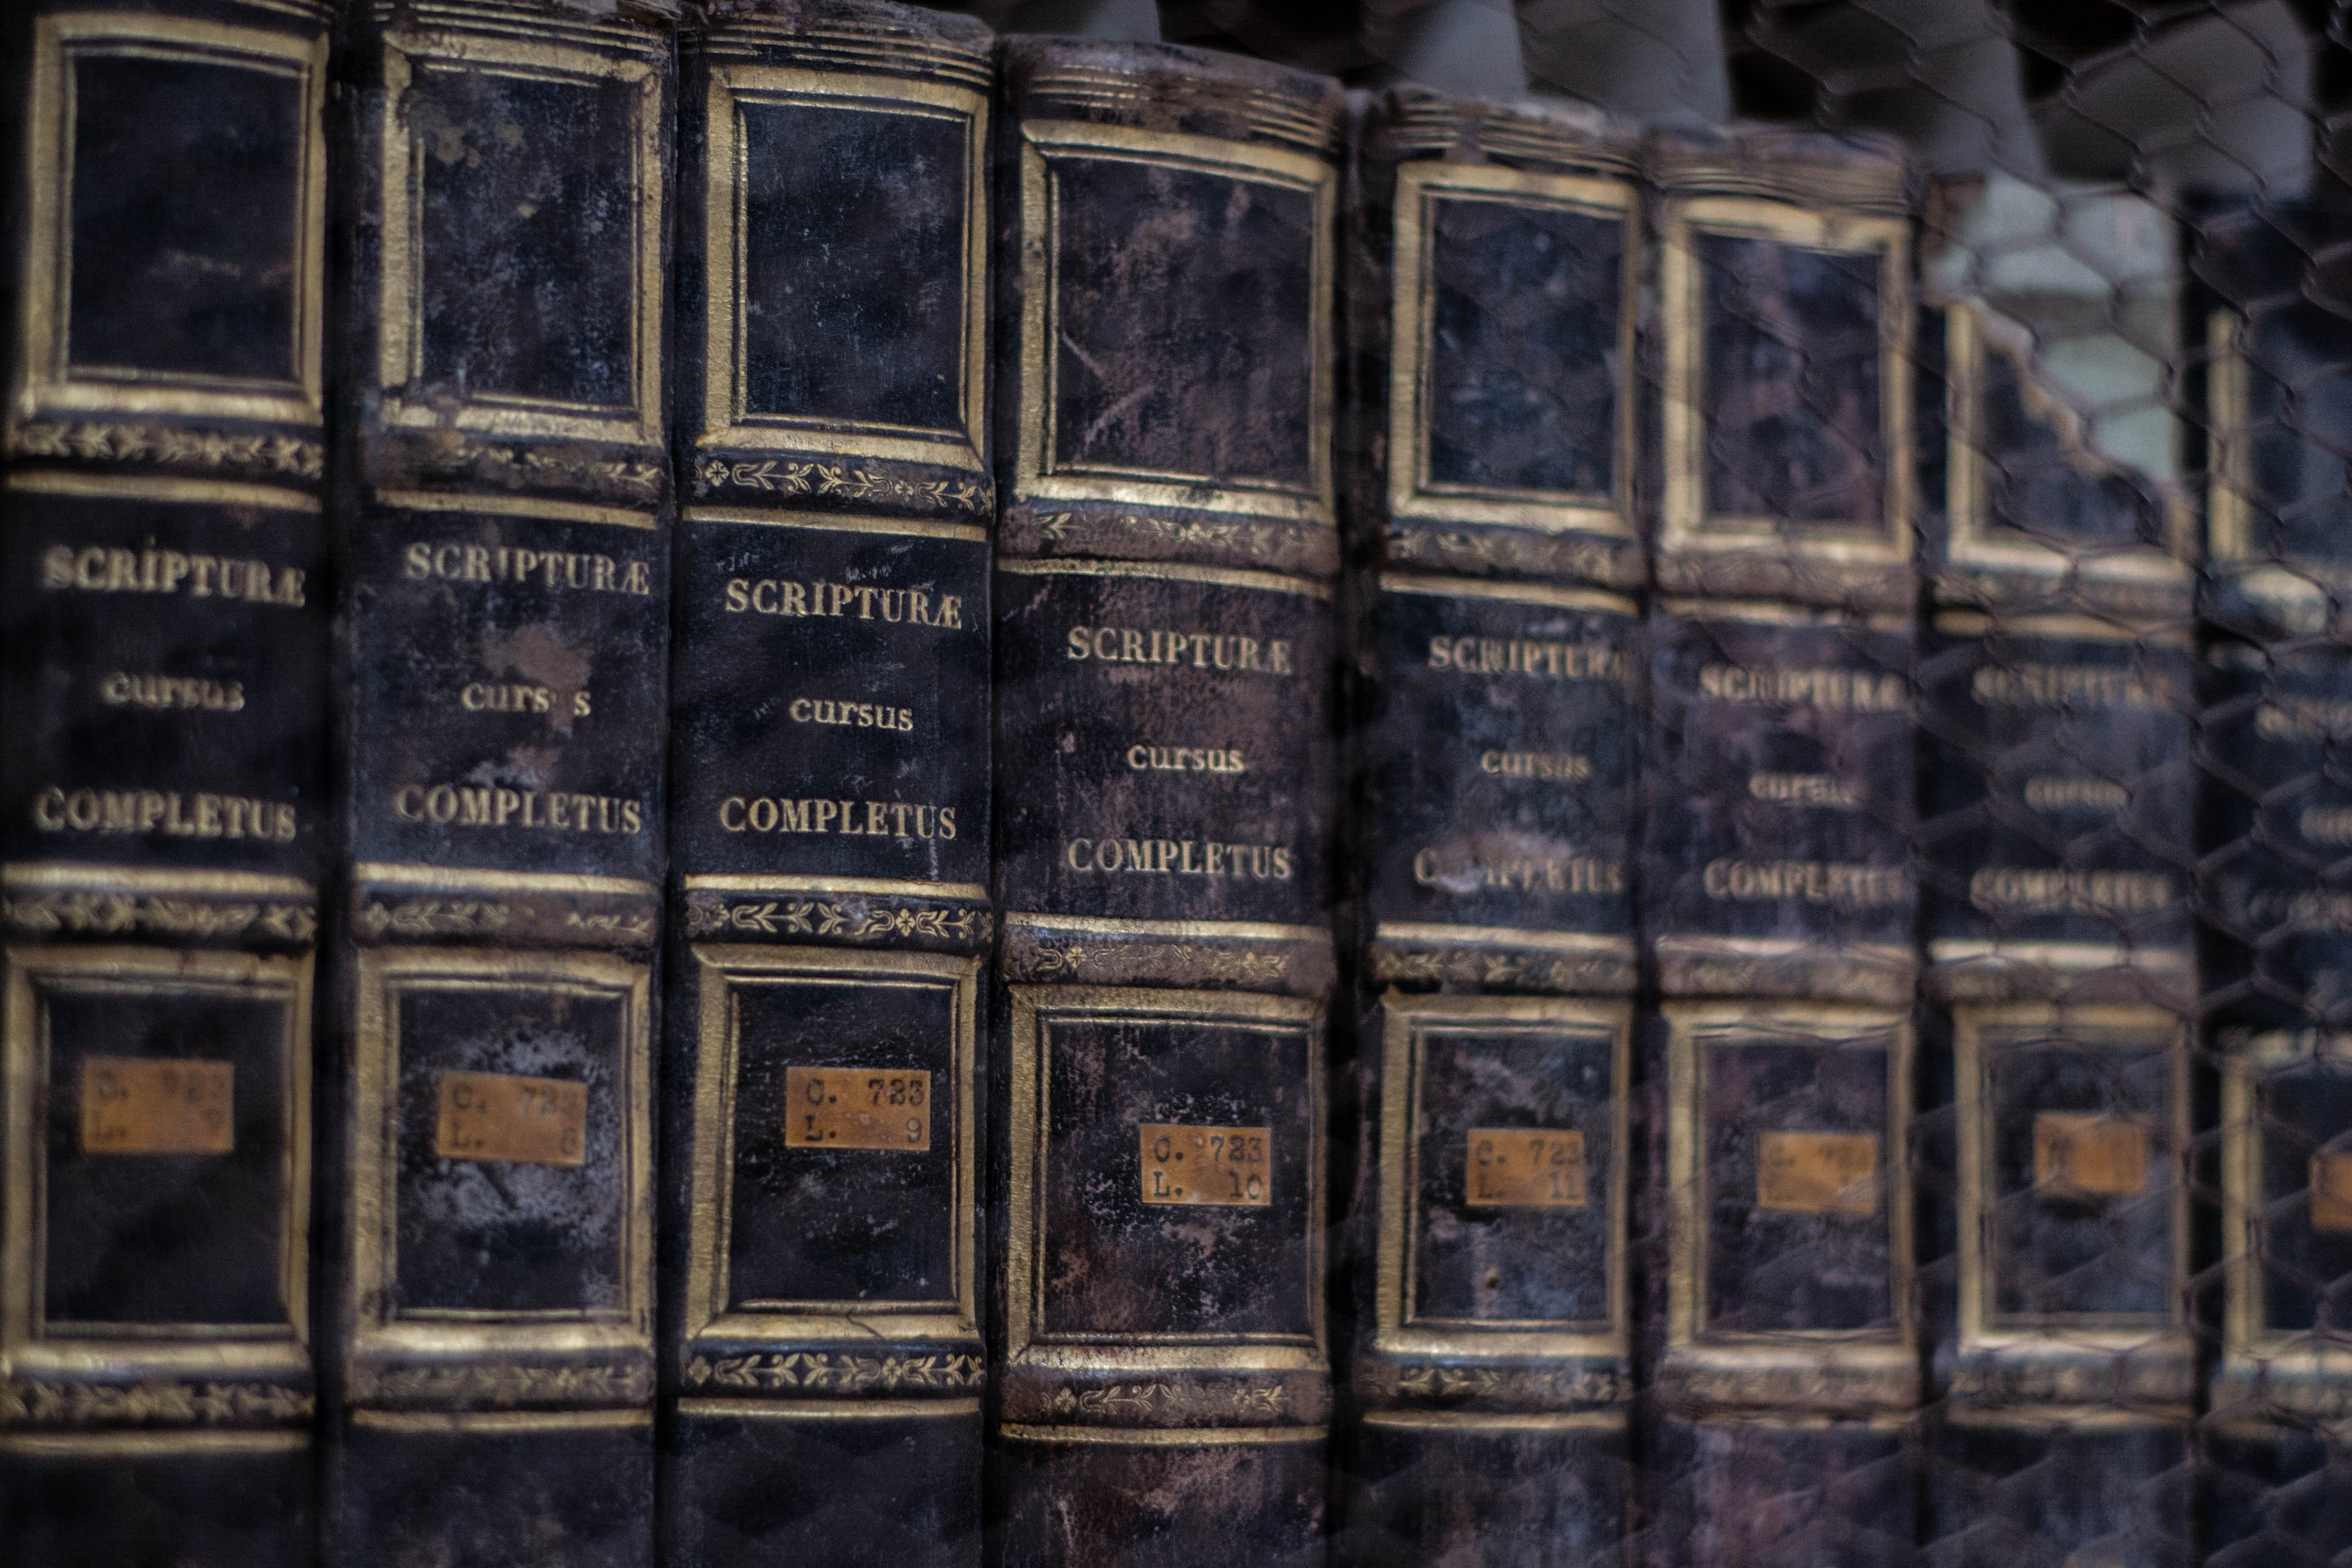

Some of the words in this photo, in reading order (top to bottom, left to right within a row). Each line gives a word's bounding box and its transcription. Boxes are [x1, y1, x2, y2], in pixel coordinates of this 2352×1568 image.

[405, 542, 651, 595] SCRIPTURÆ
[725, 578, 963, 630] SCRIPTURÆ
[1067, 626, 1293, 674] SCRIPTURÆ
[102, 672, 245, 711] cursus
[461, 681, 592, 717] curss
[790, 696, 913, 732] cursus
[1127, 743, 1246, 774] cursus
[32, 785, 297, 842] COMPLETUS
[395, 785, 641, 835] COMPLETUS
[719, 797, 956, 840] COMPLETUS
[1068, 838, 1292, 880] COMPLETUS
[805, 1079, 838, 1106] C.
[868, 1077, 925, 1107] 723
[804, 1115, 837, 1143] L.
[905, 1117, 924, 1144] 9
[1154, 1137, 1184, 1163] C.
[1210, 1136, 1263, 1163] 723
[1476, 1140, 1506, 1167] C.
[1153, 1171, 1183, 1198] L.
[1229, 1172, 1263, 1201] 10
[1550, 1172, 1580, 1200] 11
